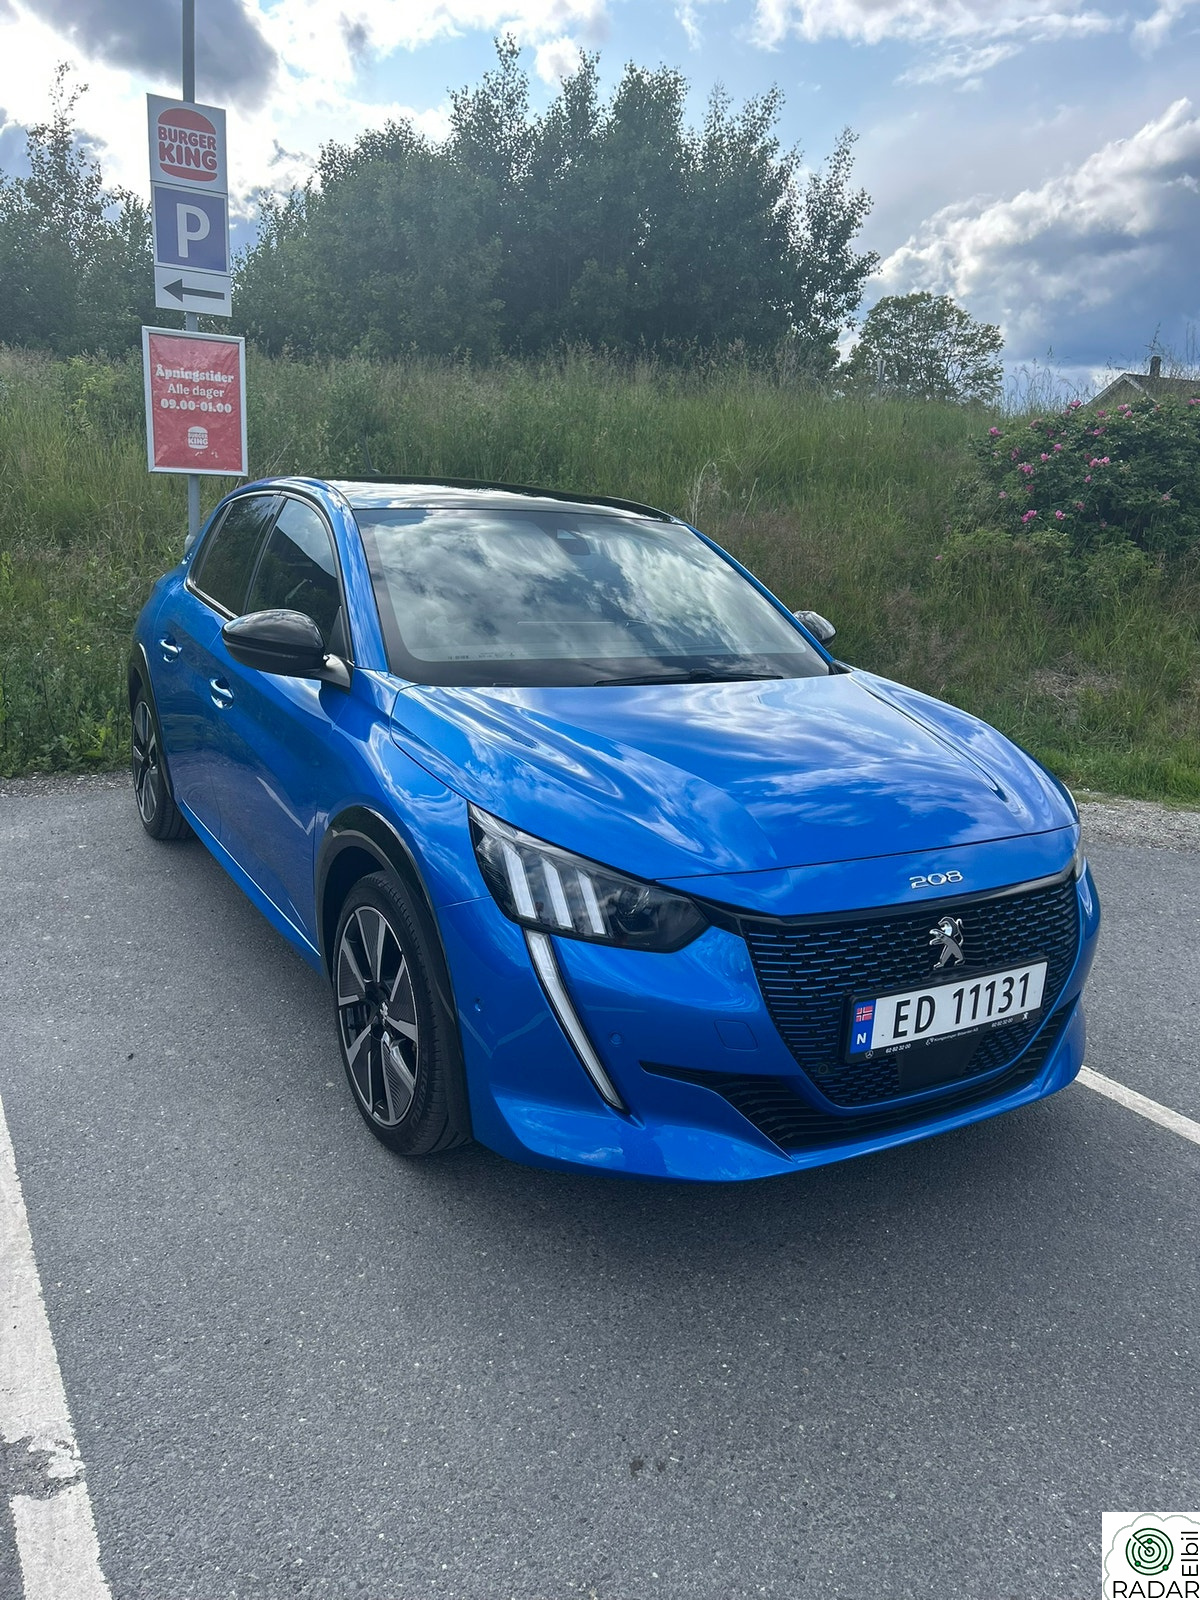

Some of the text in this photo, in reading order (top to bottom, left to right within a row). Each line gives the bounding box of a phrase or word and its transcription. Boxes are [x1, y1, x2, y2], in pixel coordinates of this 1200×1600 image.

[158, 126, 216, 151] BURGER
[158, 141, 218, 171] KING
[176, 202, 211, 258] P
[155, 363, 234, 383] Åpningstider
[168, 383, 225, 400] Alle dager
[160, 398, 232, 414] 09.00-01.00
[188, 437, 208, 446] KING
[909, 870, 964, 889] 208
[892, 972, 1030, 1039] ED 11131
[856, 1032, 867, 1045] N
